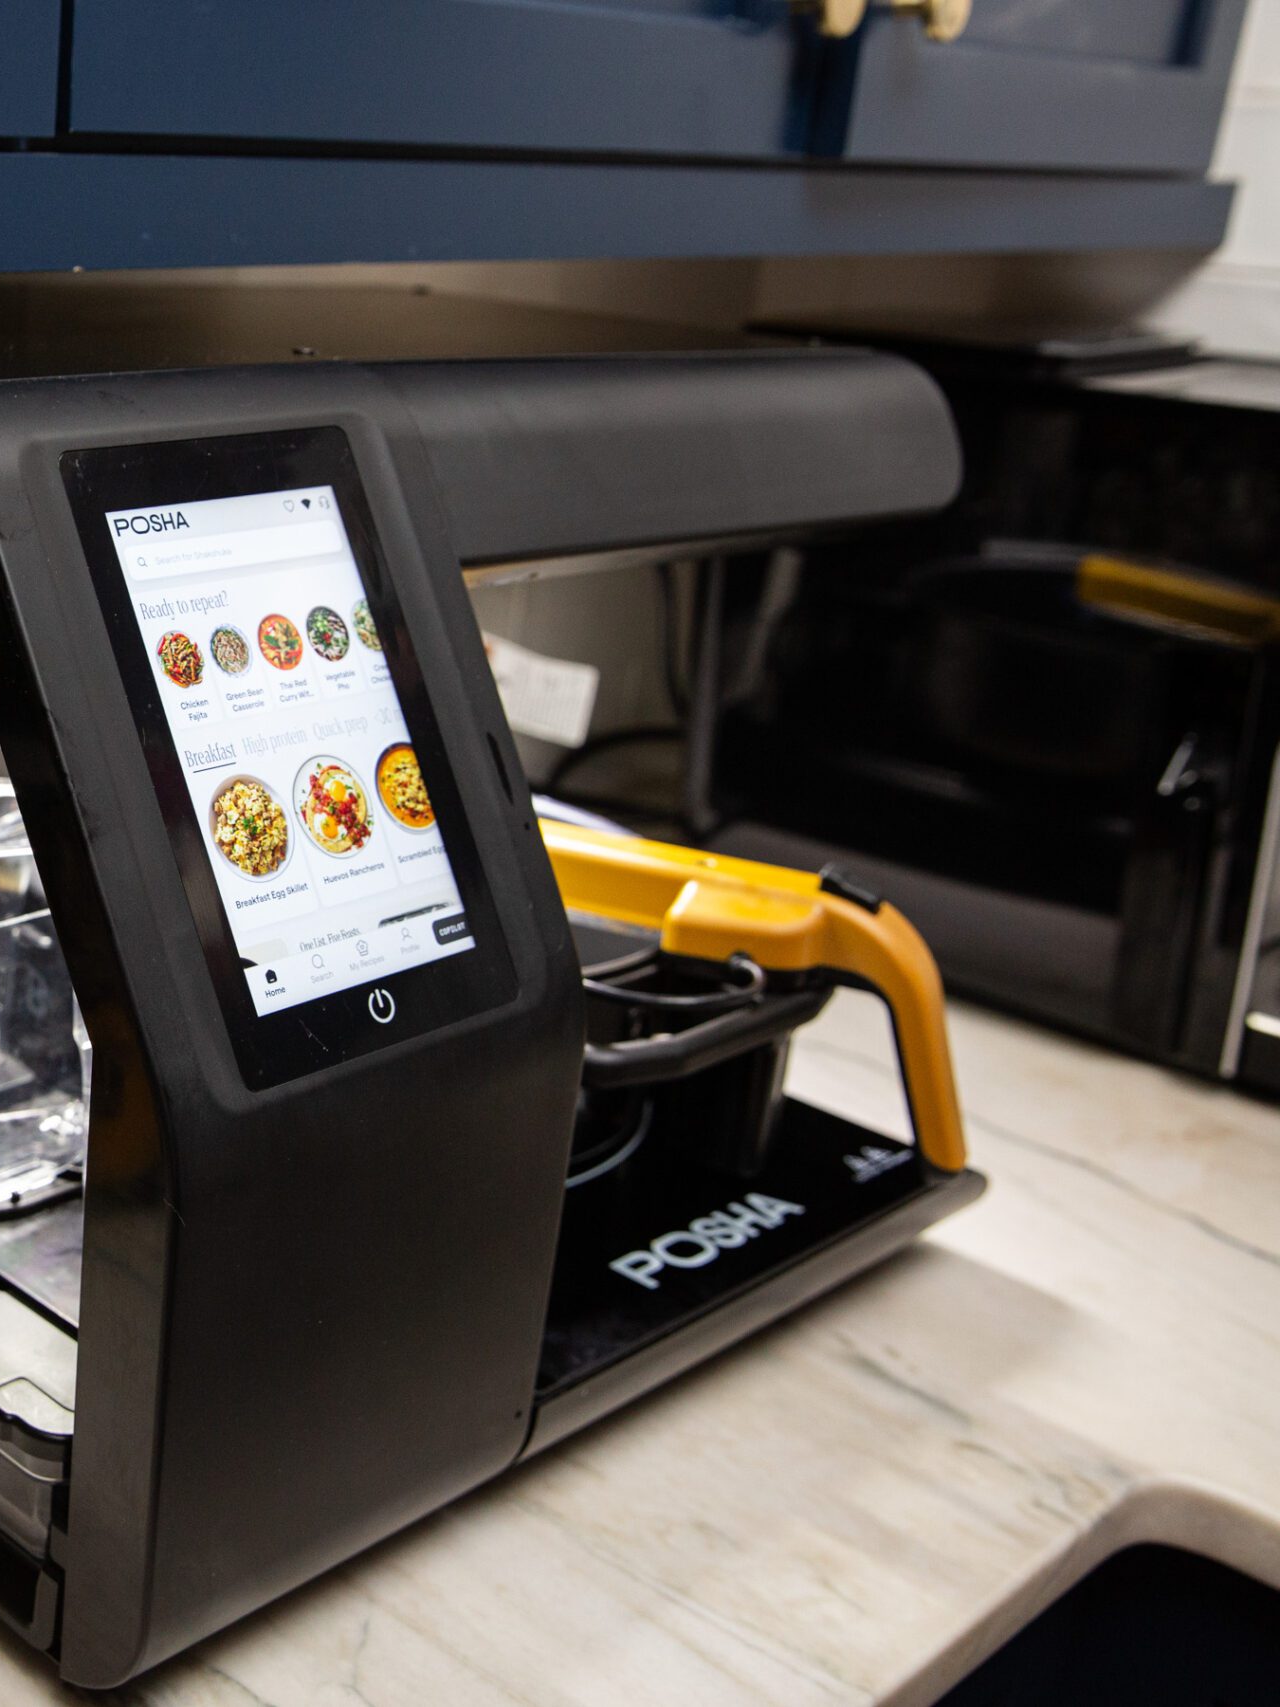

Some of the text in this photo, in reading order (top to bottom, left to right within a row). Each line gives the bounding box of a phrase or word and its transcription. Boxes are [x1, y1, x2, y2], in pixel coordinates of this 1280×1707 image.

[113, 511, 190, 537] POSHA
[140, 590, 229, 620] Ready to repeat?
[294, 678, 307, 688] Red
[226, 687, 265, 702] Green Bean
[279, 692, 298, 703] Curry
[180, 698, 209, 711] Chicken
[232, 700, 265, 713] Casserole
[188, 711, 208, 723] Fajita
[184, 742, 238, 768] Breakfast
[241, 734, 268, 757] High
[268, 729, 308, 754] protein
[312, 717, 345, 741] Quick
[344, 716, 368, 737] prep
[323, 861, 385, 885] Huevos Rancheros
[235, 881, 309, 910] Breakfast Egg Skillet
[299, 942, 314, 953] One
[310, 971, 334, 984] Search
[264, 985, 286, 998] Home
[608, 1192, 807, 1290] POSHA
